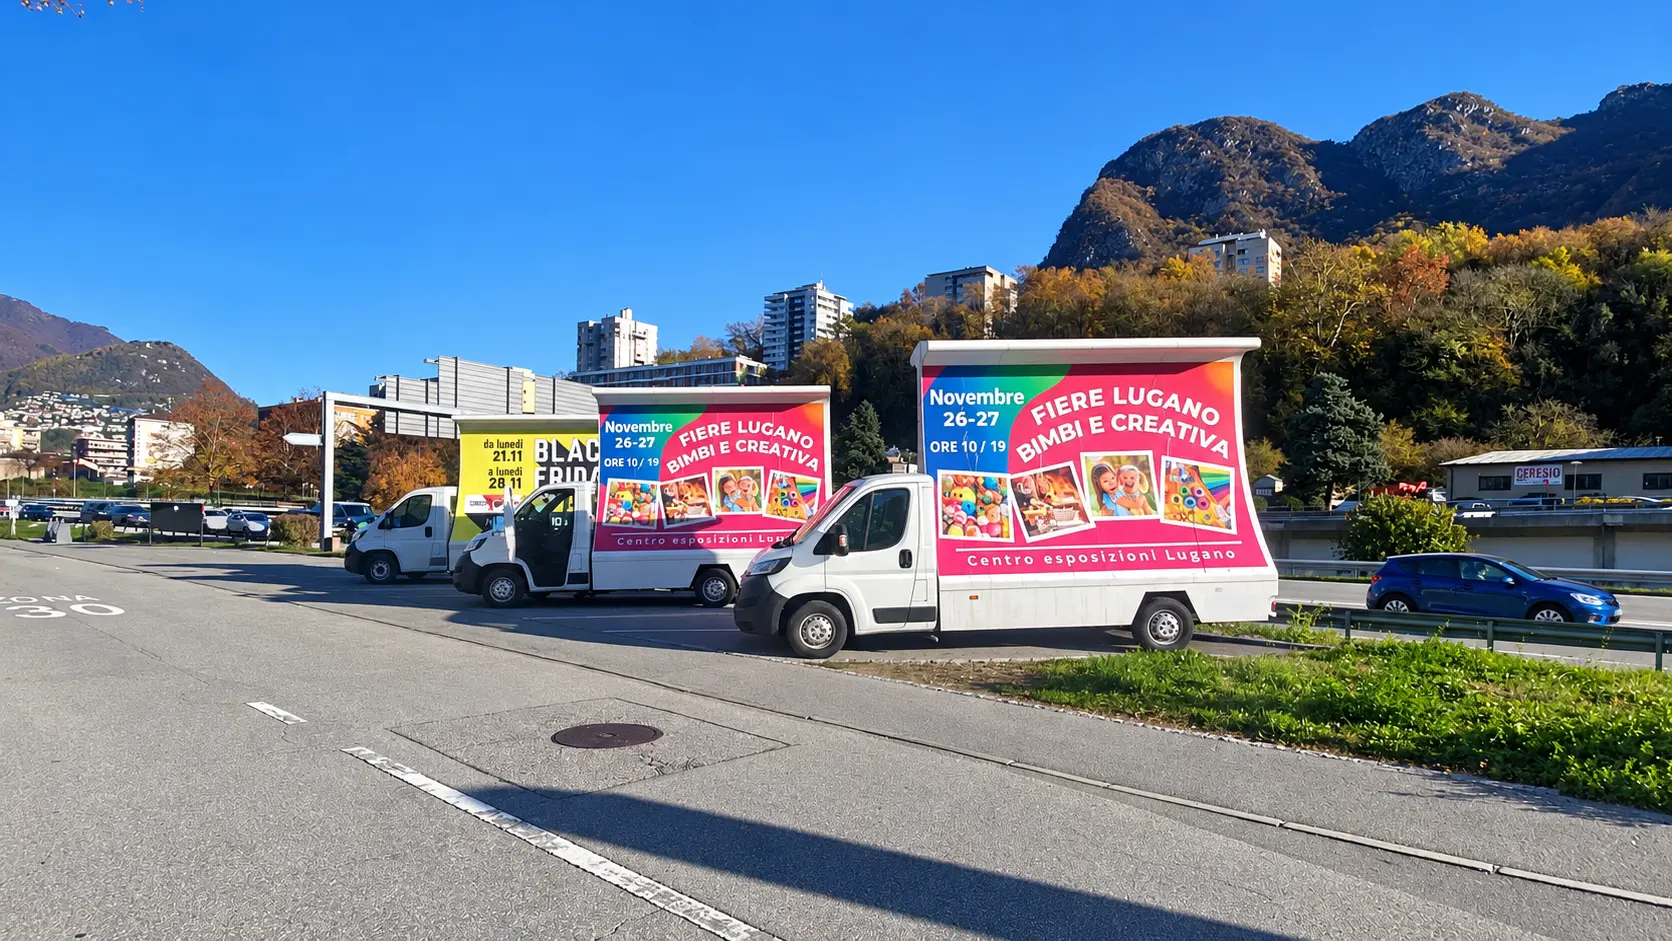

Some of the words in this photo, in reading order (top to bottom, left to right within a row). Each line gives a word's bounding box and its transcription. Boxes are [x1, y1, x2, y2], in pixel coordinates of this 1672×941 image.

[930, 388, 1024, 406] Novembre
[1031, 388, 1104, 425] FIERE
[1114, 387, 1220, 426] LUGANO
[943, 411, 999, 427] 26-27
[605, 420, 672, 433] Novembre
[679, 421, 731, 447] FIERE
[738, 420, 813, 449] LUGANO
[1016, 422, 1082, 463] BIMBI
[1089, 416, 1105, 434] E
[1110, 413, 1230, 459] CREATIVA
[484, 439, 494, 448] da
[615, 437, 655, 448] 26-27
[930, 441, 959, 453] ORE
[962, 441, 977, 452] 10
[990, 440, 1006, 452] 19
[493, 451, 522, 462] 21.11
[535, 438, 599, 462] BLAC
[604, 458, 624, 467] ORE
[648, 458, 659, 467] 19
[666, 447, 715, 474] BIMBI
[720, 441, 731, 454] E
[736, 440, 819, 472] CREATIVA
[1517, 468, 1560, 478] CERESIO
[489, 478, 522, 489] 2811
[618, 537, 665, 546] Centro
[673, 535, 753, 547] esposizioni
[968, 555, 1033, 567] Centro
[1044, 550, 1156, 568] esposizioni
[1166, 549, 1236, 564] Lugano
[6, 604, 125, 618] 30
